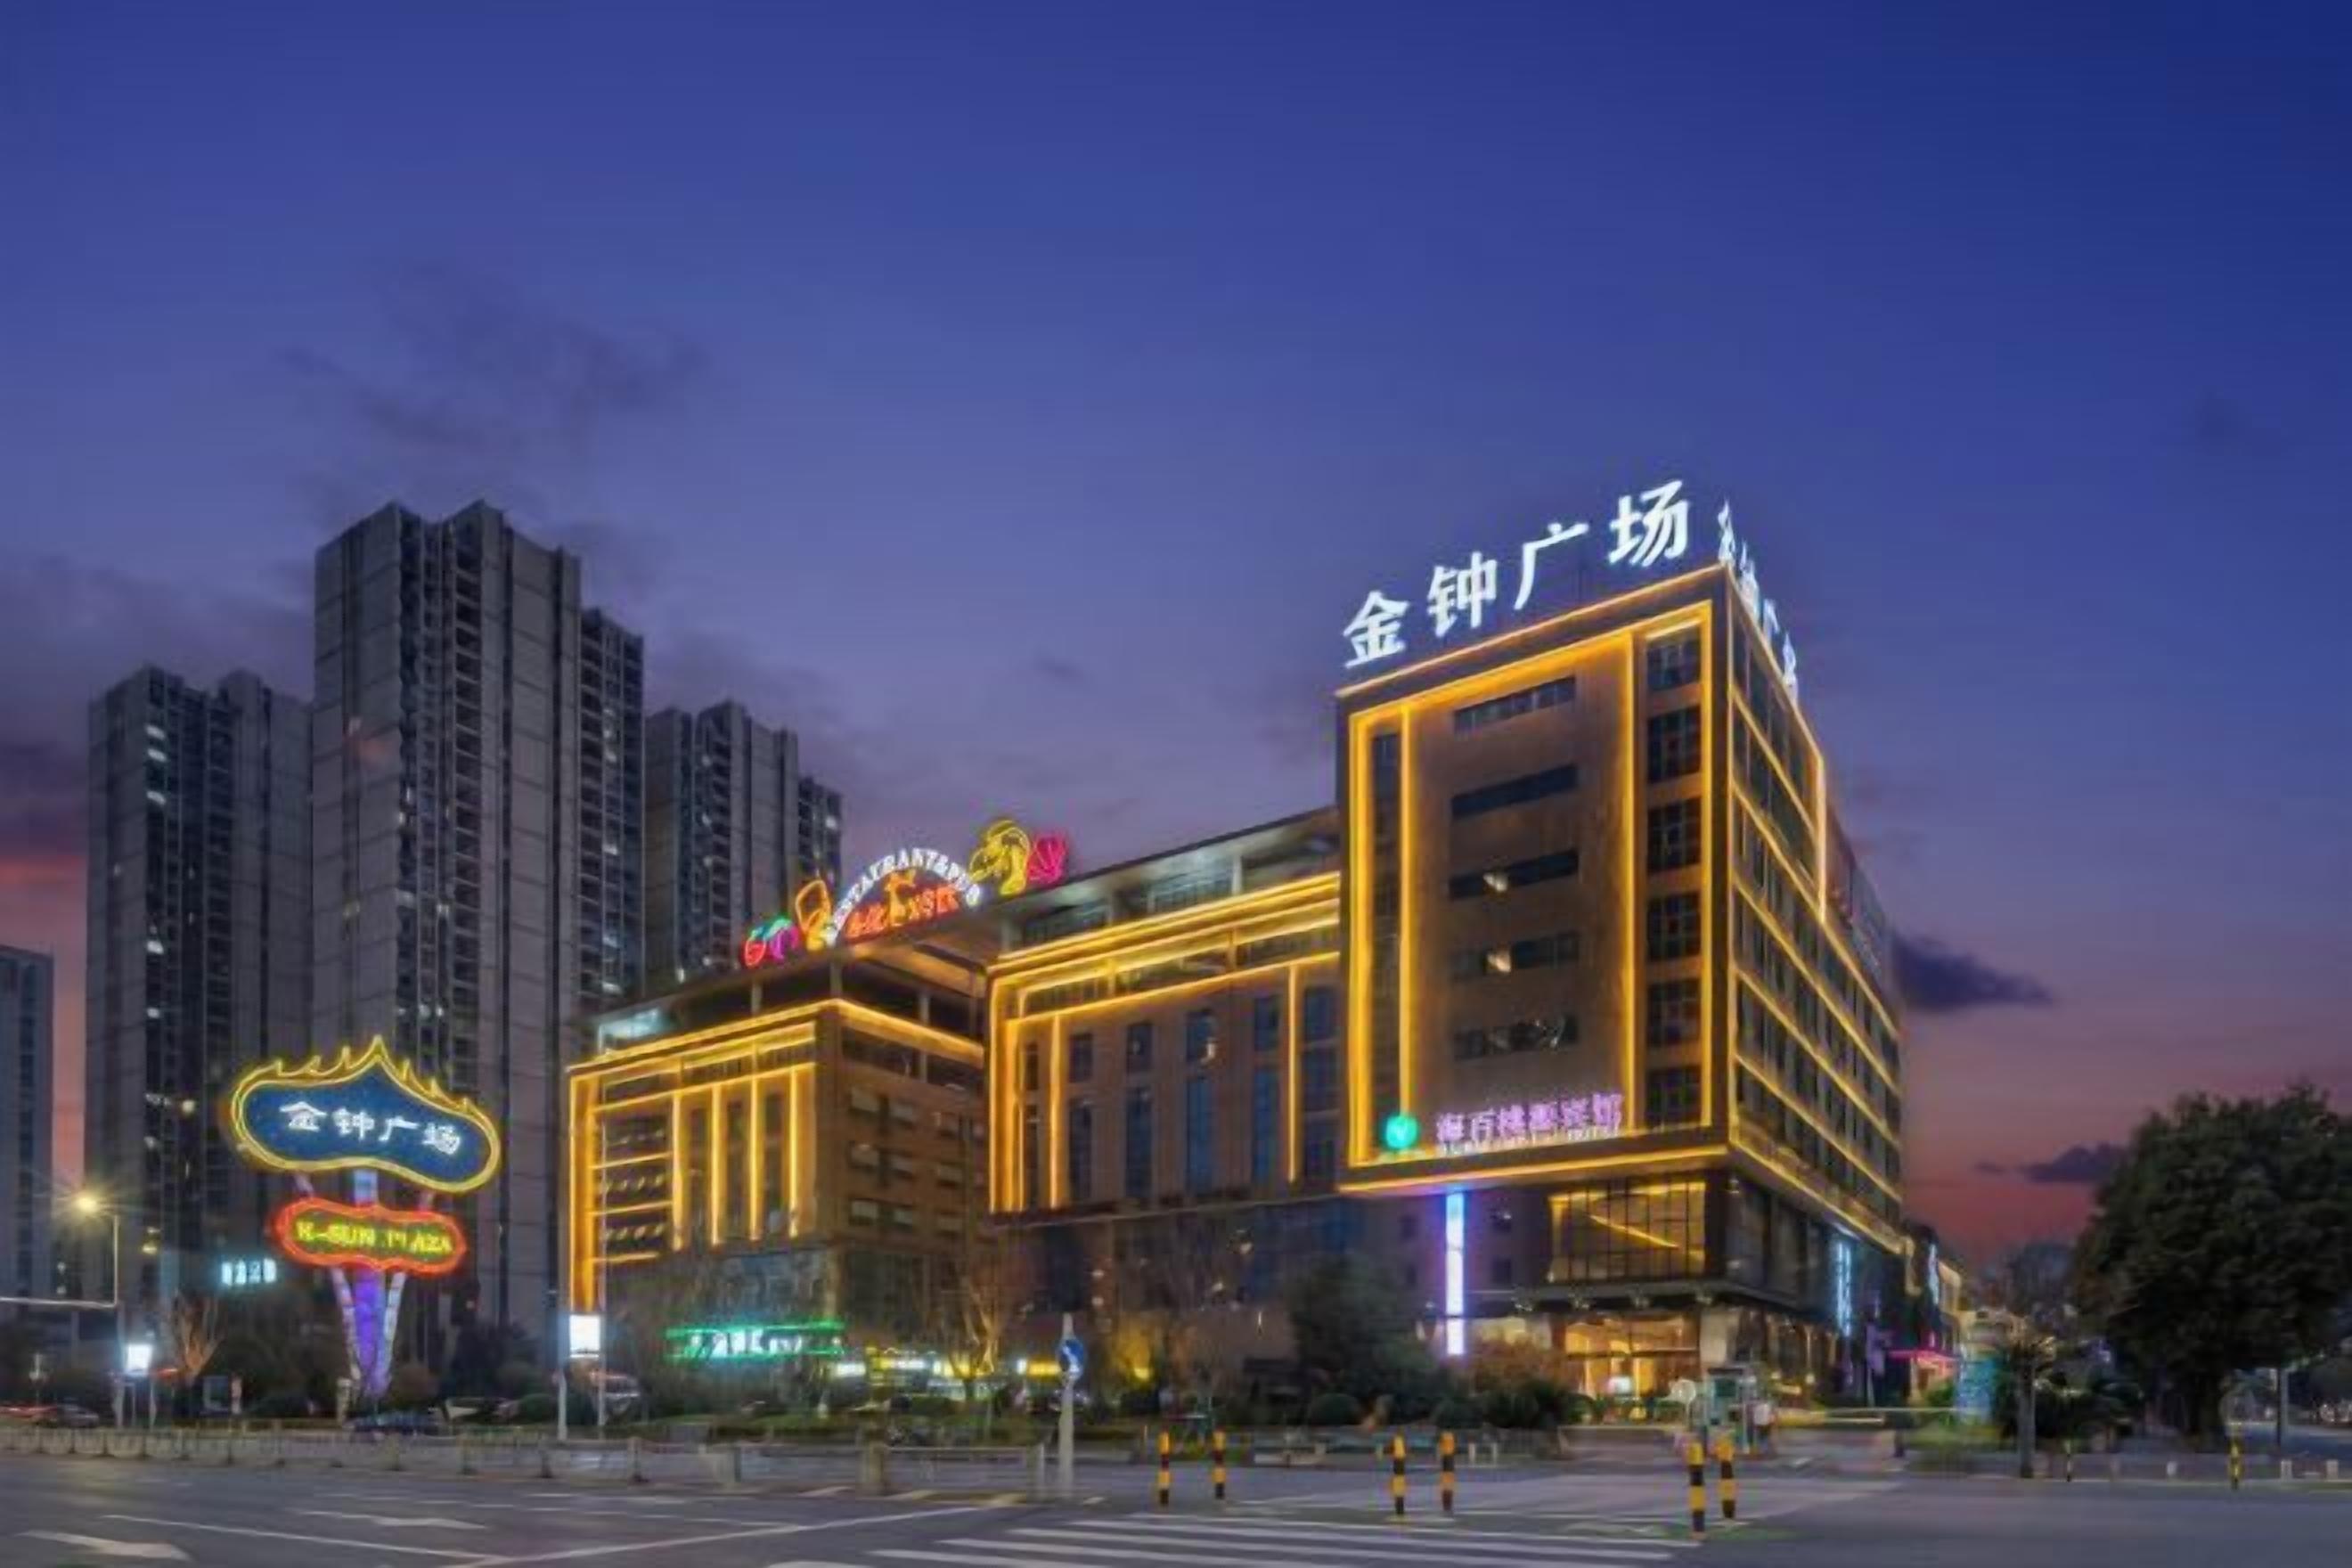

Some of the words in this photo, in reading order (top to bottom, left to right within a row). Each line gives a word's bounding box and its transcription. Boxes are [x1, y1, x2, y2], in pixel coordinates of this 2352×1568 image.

[1343, 480, 1690, 668] 金钟广场
[279, 1100, 462, 1156] 金钟广场
